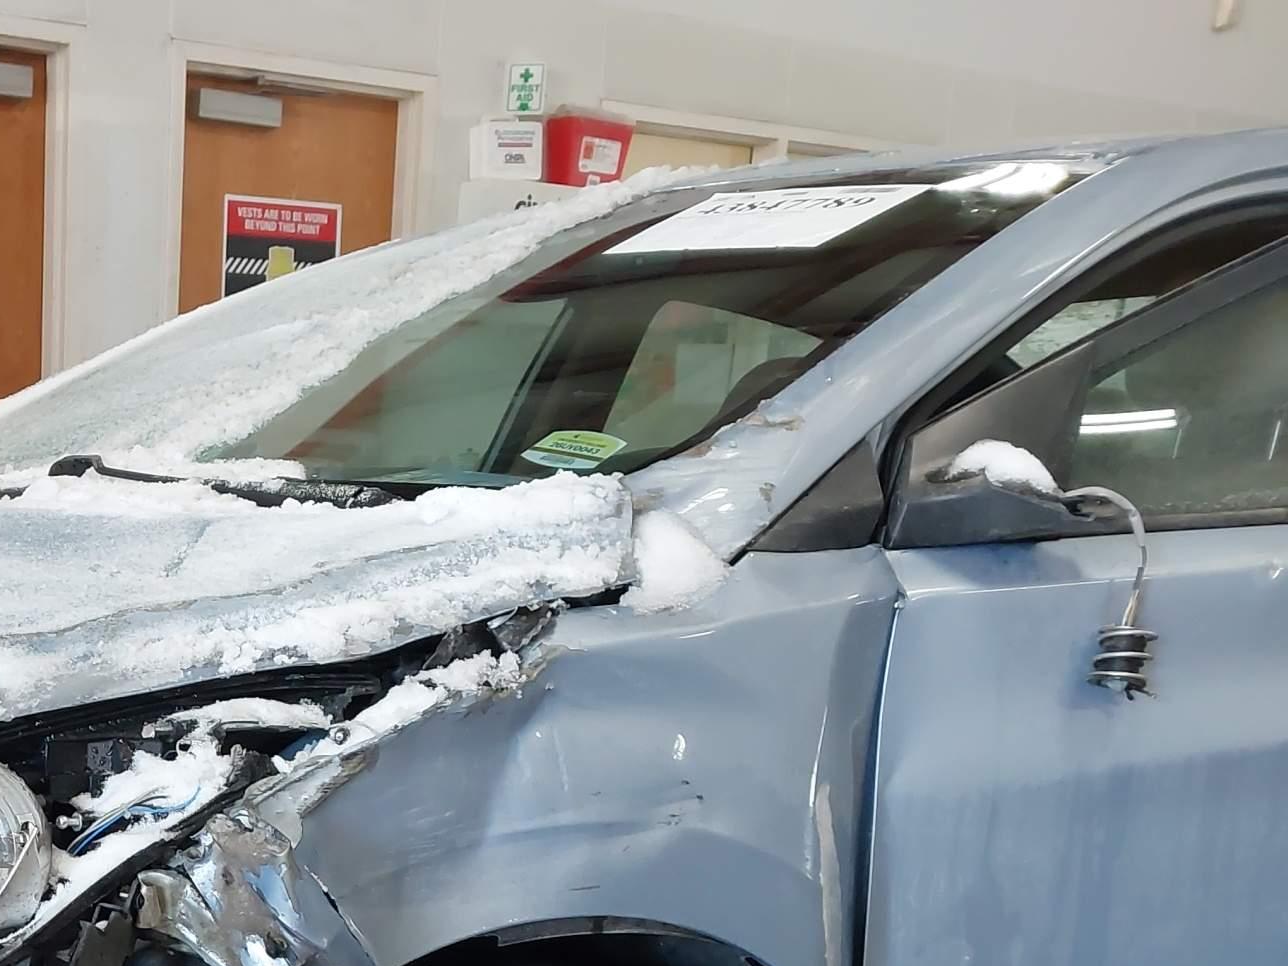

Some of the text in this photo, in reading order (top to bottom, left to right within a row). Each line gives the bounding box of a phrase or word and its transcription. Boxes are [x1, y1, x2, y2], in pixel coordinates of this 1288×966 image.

[511, 84, 540, 92] FIRST
[516, 94, 534, 102] AID
[696, 196, 877, 215] 43847789
[237, 207, 328, 224] VESTS ARE TO BE WORN
[244, 219, 320, 235] BEYOND THIS POINT
